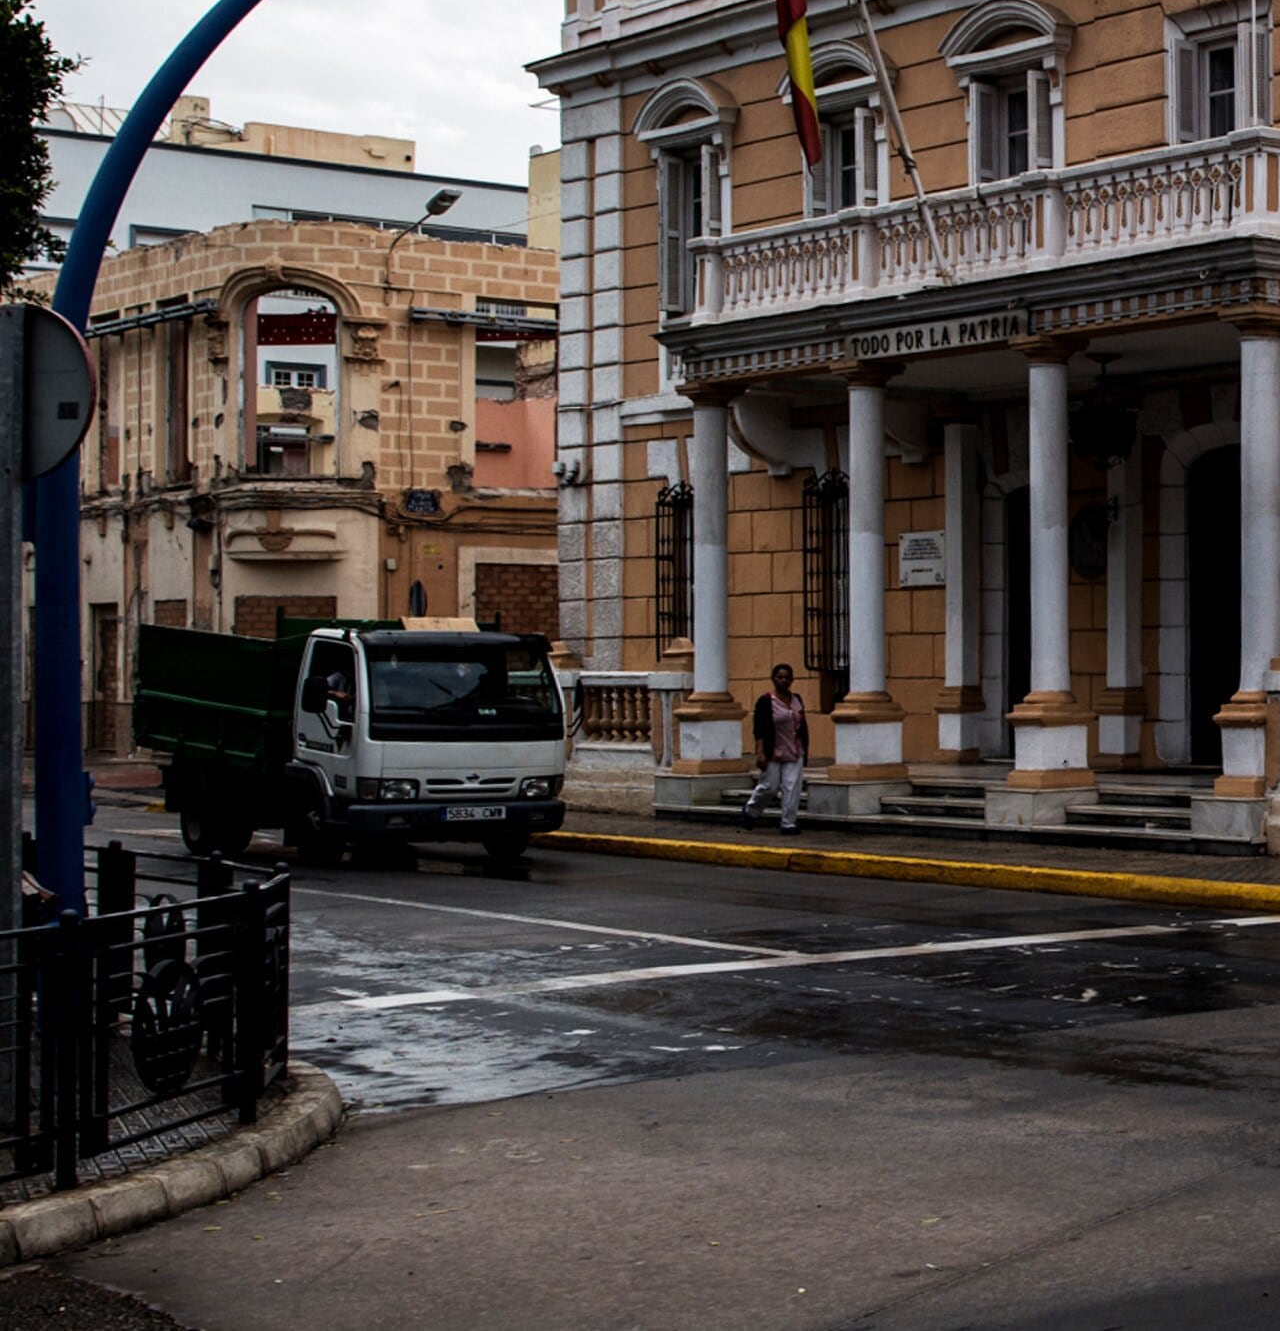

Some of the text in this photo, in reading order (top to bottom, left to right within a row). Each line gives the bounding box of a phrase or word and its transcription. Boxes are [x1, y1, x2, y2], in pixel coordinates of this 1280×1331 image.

[852, 315, 1020, 357] TODO POR LA PATRIA
